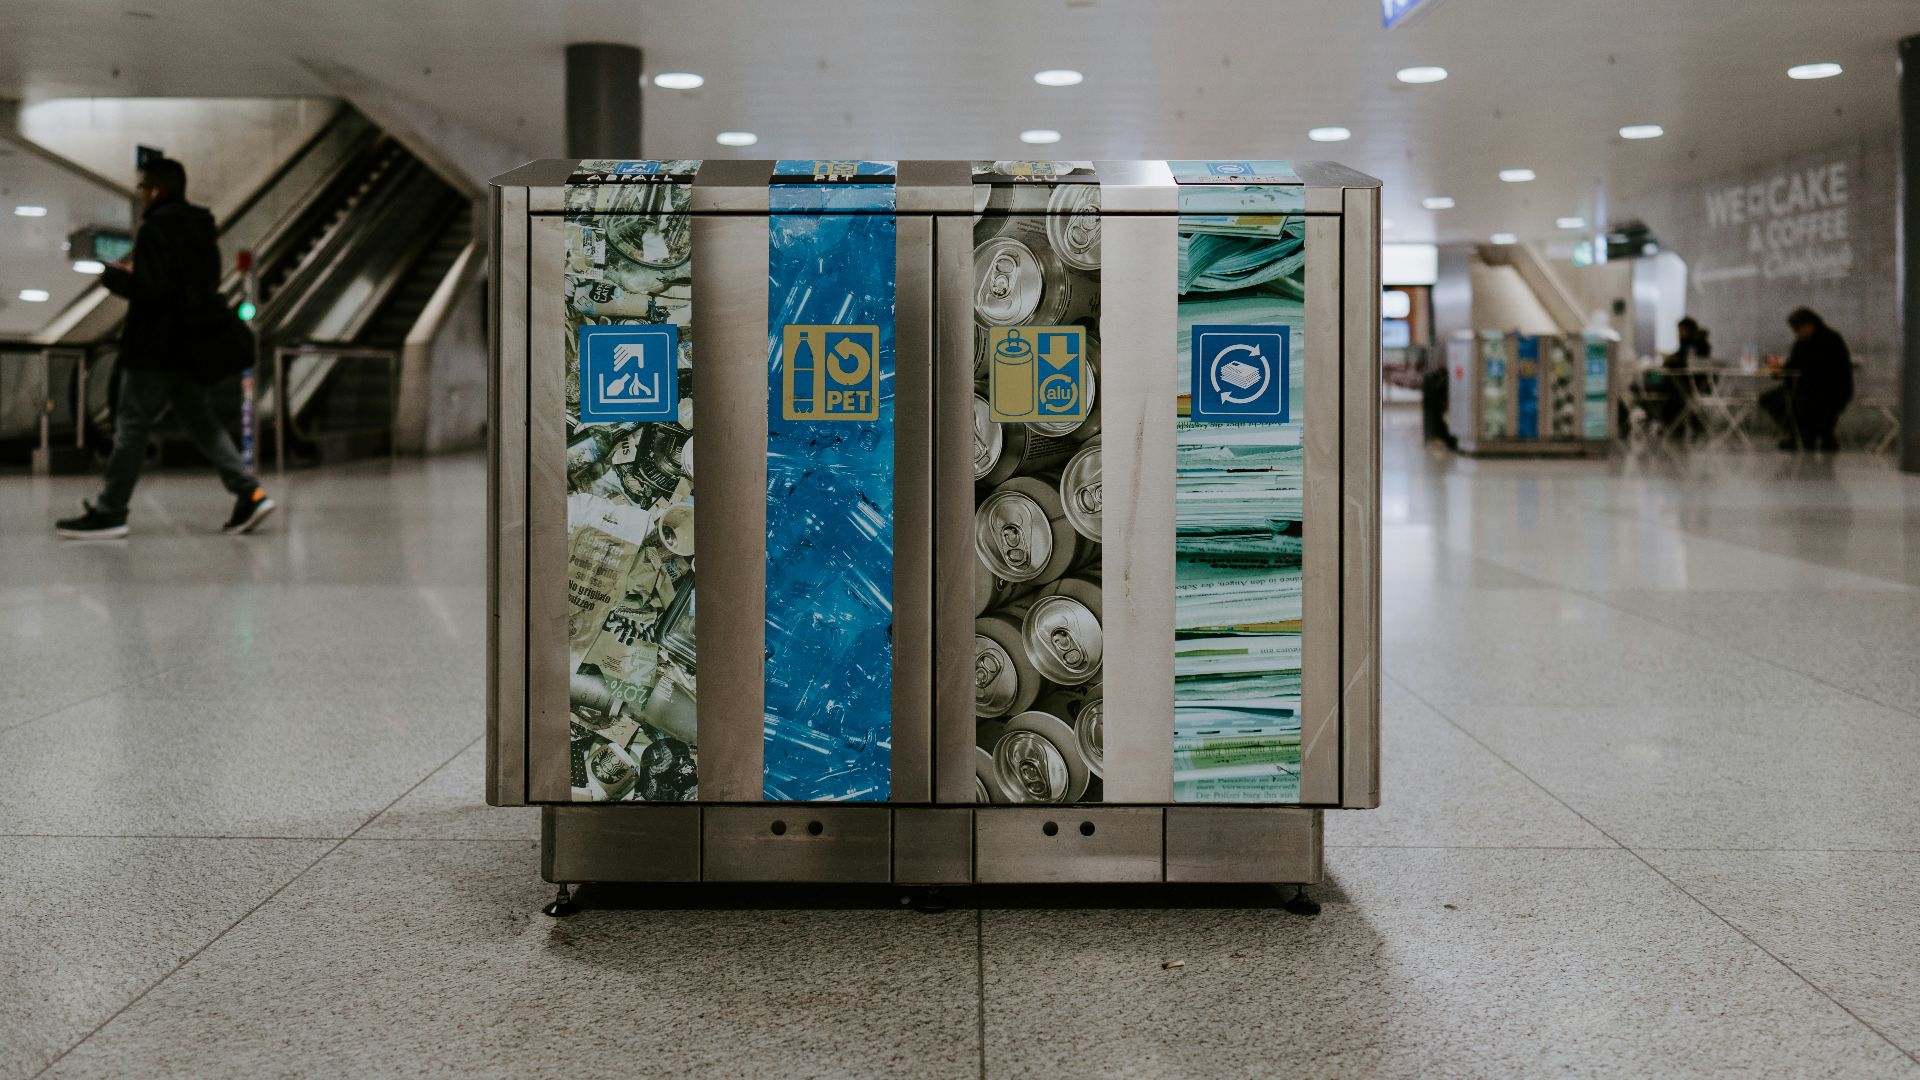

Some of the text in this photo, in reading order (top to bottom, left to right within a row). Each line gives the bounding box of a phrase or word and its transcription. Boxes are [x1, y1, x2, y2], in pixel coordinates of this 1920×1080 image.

[1014, 174, 1057, 182] ALU
[1768, 162, 1848, 217] CAKE
[1767, 207, 1848, 250] COFFEE
[827, 390, 870, 411] PET
[1046, 386, 1071, 400] alu
